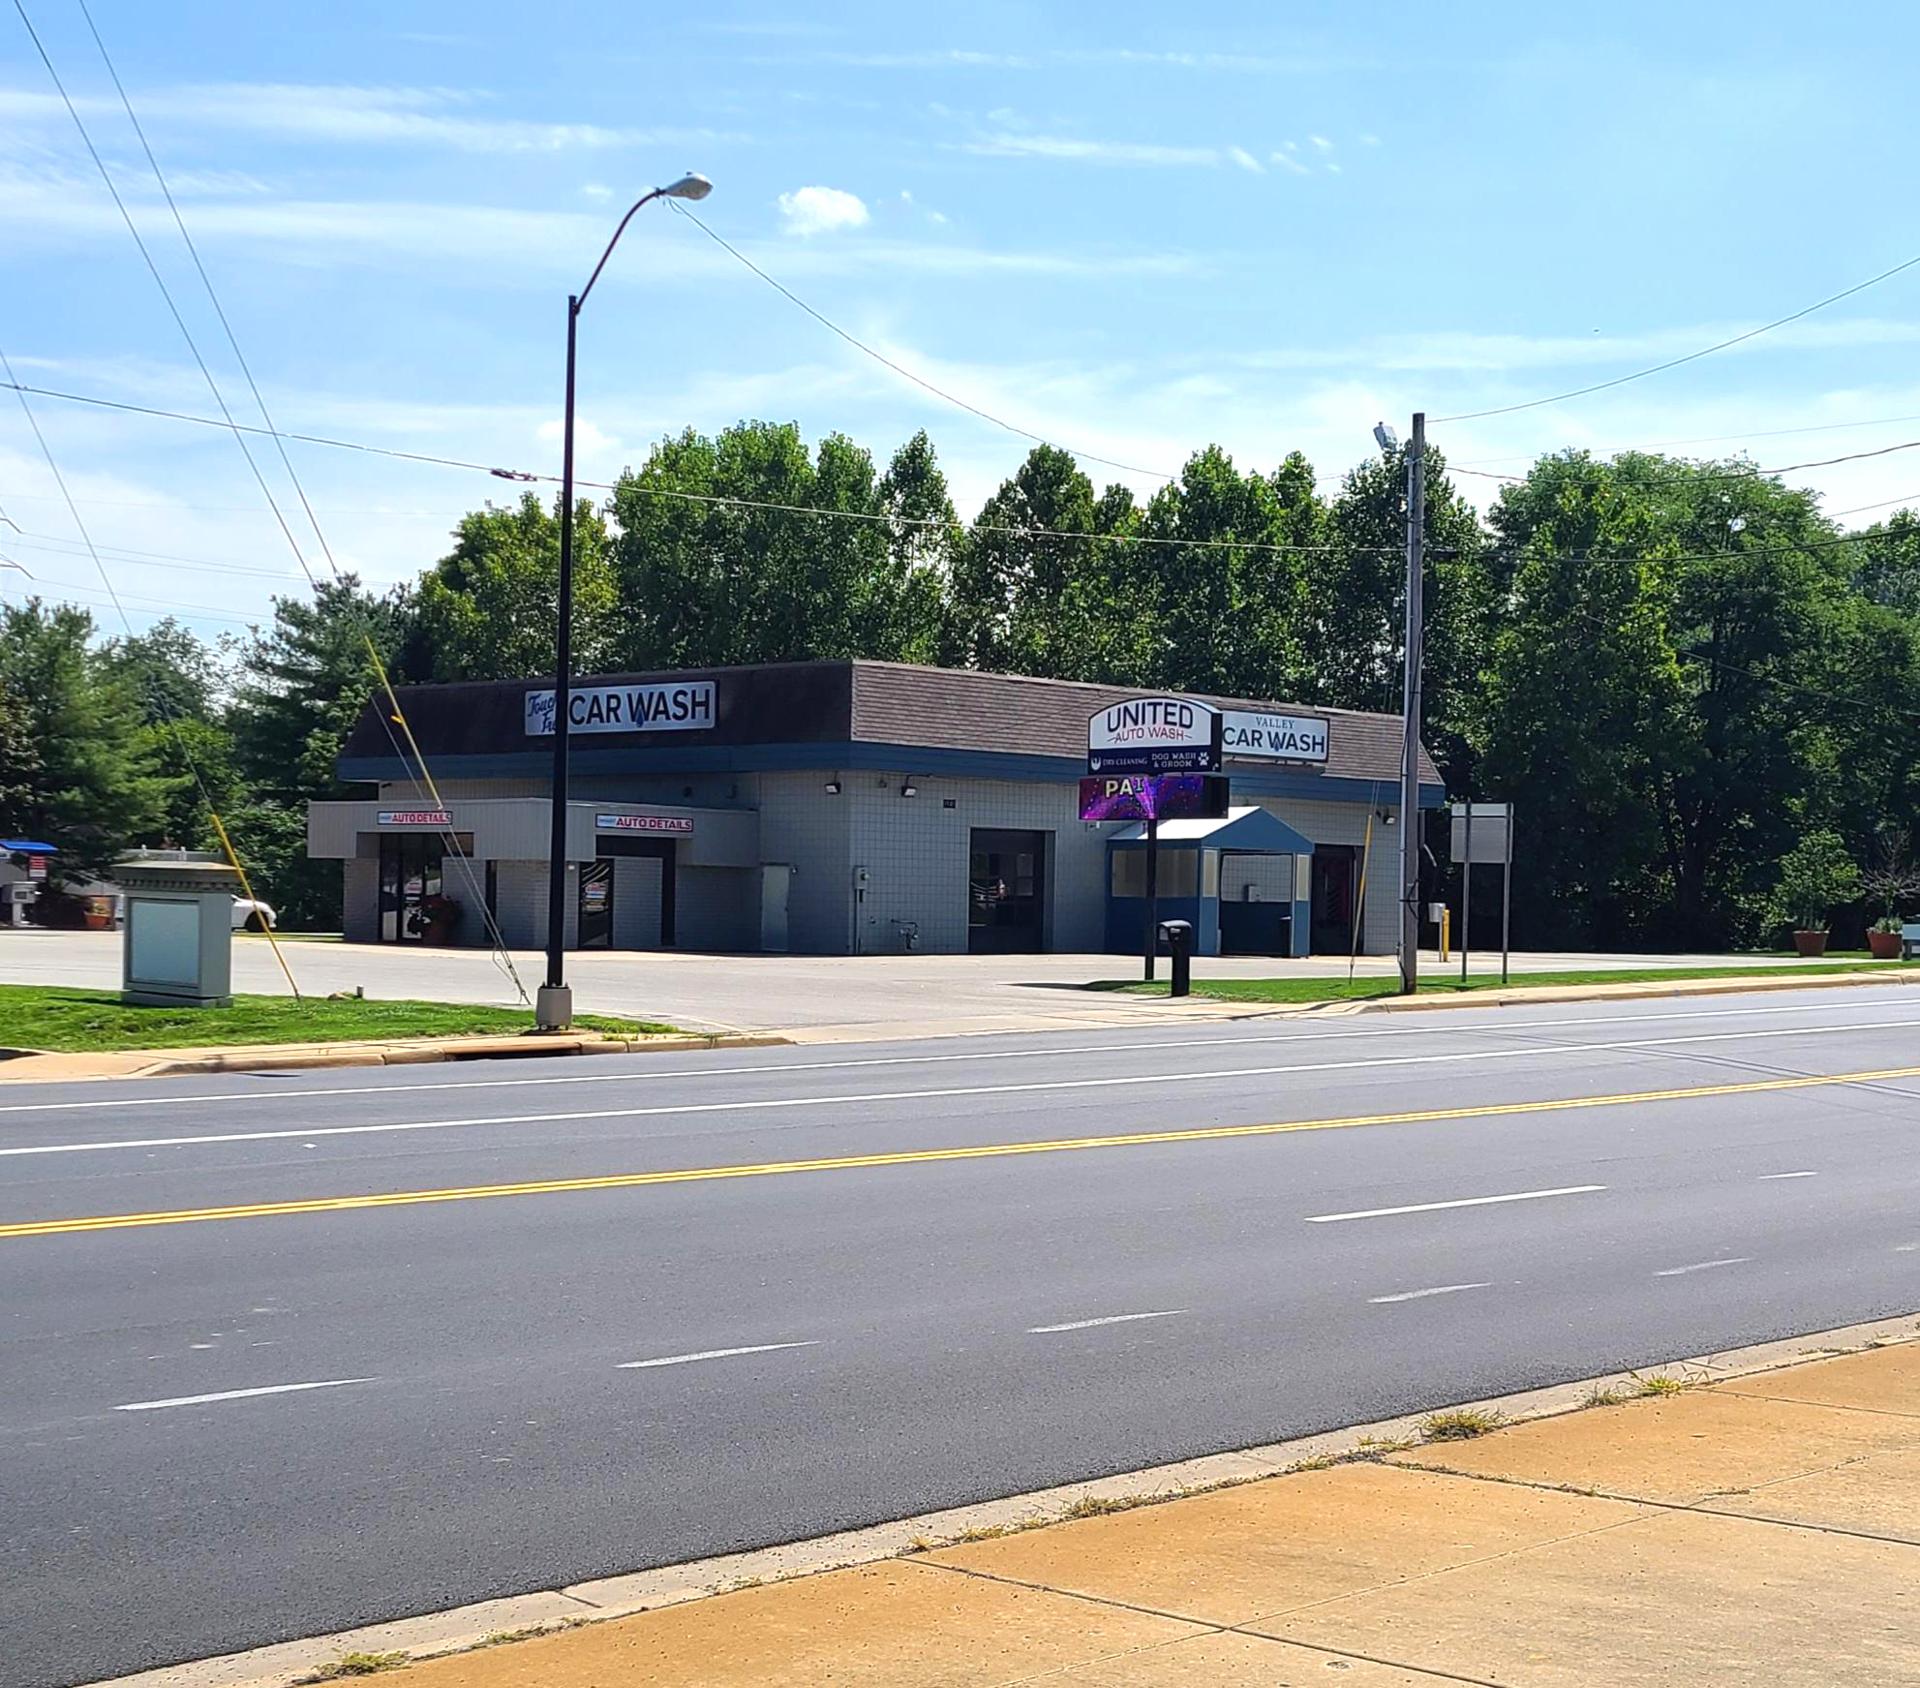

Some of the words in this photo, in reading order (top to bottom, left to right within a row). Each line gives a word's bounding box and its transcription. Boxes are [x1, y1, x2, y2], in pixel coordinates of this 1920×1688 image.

[528, 693, 556, 716] Touc
[569, 694, 621, 725] CAR
[627, 689, 711, 723] WASH
[1107, 701, 1194, 732] UNITED
[1256, 716, 1295, 729] VALLEY
[1114, 728, 1144, 743] AUTO
[1148, 727, 1184, 741] WASH
[1222, 727, 1262, 748] CAR
[1267, 730, 1325, 753] WASH
[1116, 757, 1148, 766] CLEANING
[1171, 752, 1197, 760] WASH
[1161, 760, 1192, 768] GROOM
[392, 813, 416, 822] AUTO
[616, 817, 647, 827] AUTO
[649, 819, 691, 830] DETAILS
